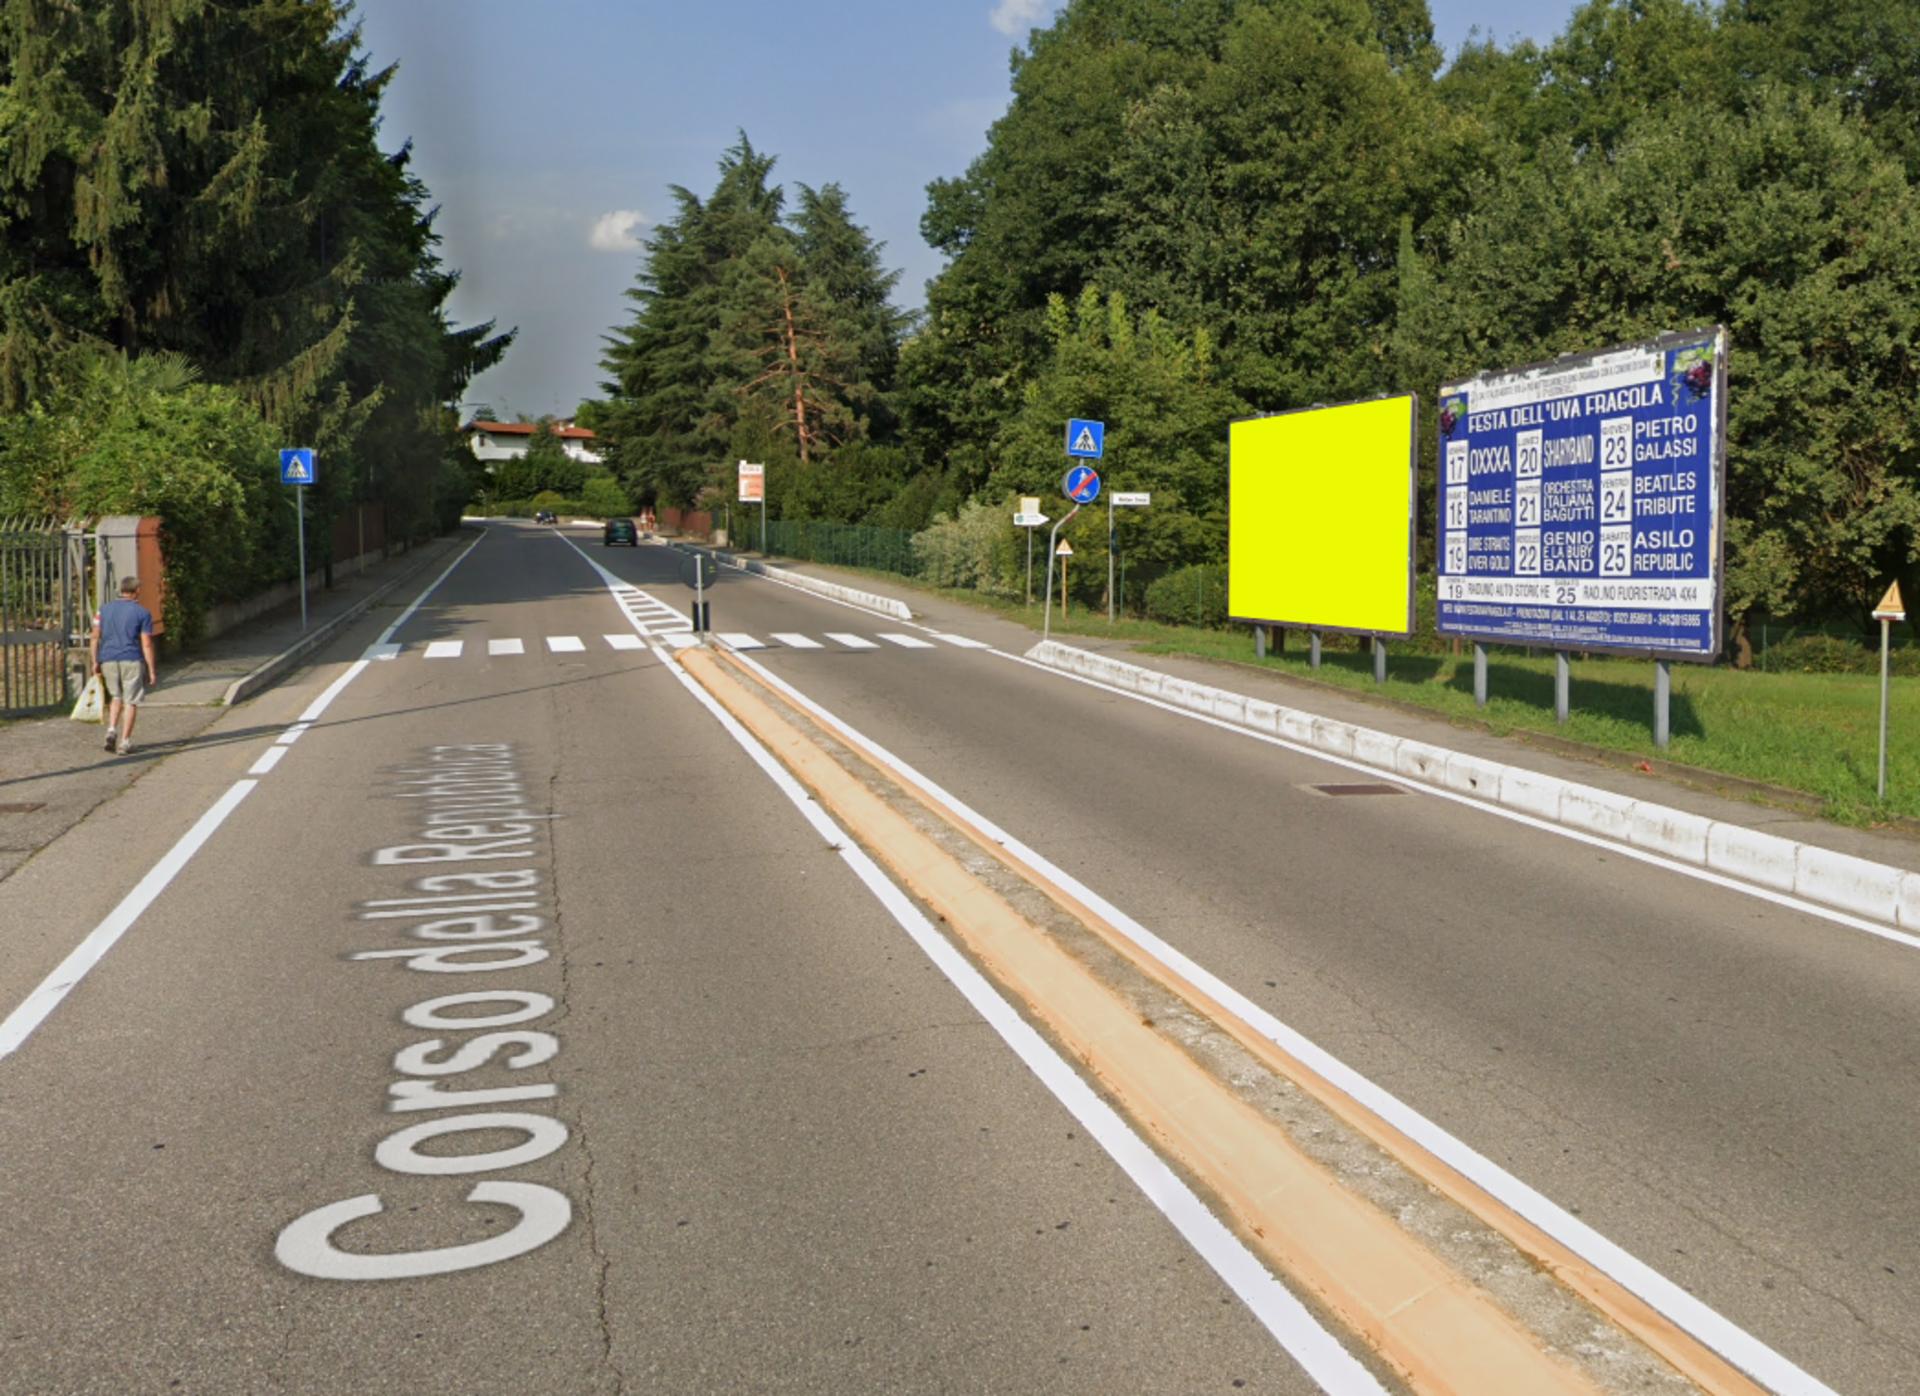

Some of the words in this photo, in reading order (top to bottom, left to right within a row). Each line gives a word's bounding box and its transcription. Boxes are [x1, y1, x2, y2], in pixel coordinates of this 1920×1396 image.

[1468, 412, 1507, 433] FESTA
[1511, 400, 1581, 426] DELL'UVA
[1585, 384, 1663, 416] FRAGOLA
[1635, 414, 1697, 440] PIETRO
[1520, 447, 1538, 474] 20
[1605, 436, 1628, 465] 23
[1635, 437, 1697, 461] GALASSI
[1450, 456, 1465, 480] 17
[1543, 479, 1594, 496] ORCHESTRA
[1635, 471, 1696, 494] BEATLES
[1469, 488, 1512, 506] DANIELE
[1604, 490, 1625, 518] 24
[1634, 495, 1695, 516] TRIBUTE
[1519, 496, 1536, 522] 21
[1543, 506, 1594, 522] BAGUTTI
[1543, 530, 1594, 546] GENIO
[1634, 529, 1694, 549] ASILO
[1449, 547, 1463, 570] 19
[1519, 545, 1536, 571] 22
[1543, 546, 1549, 558] E
[1552, 545, 1564, 558] LA
[1604, 544, 1626, 571] 25
[1634, 552, 1694, 571] REPUBLIC
[1543, 558, 1594, 572] BAND
[1448, 584, 1463, 598] 19
[1556, 587, 1577, 605] 25
